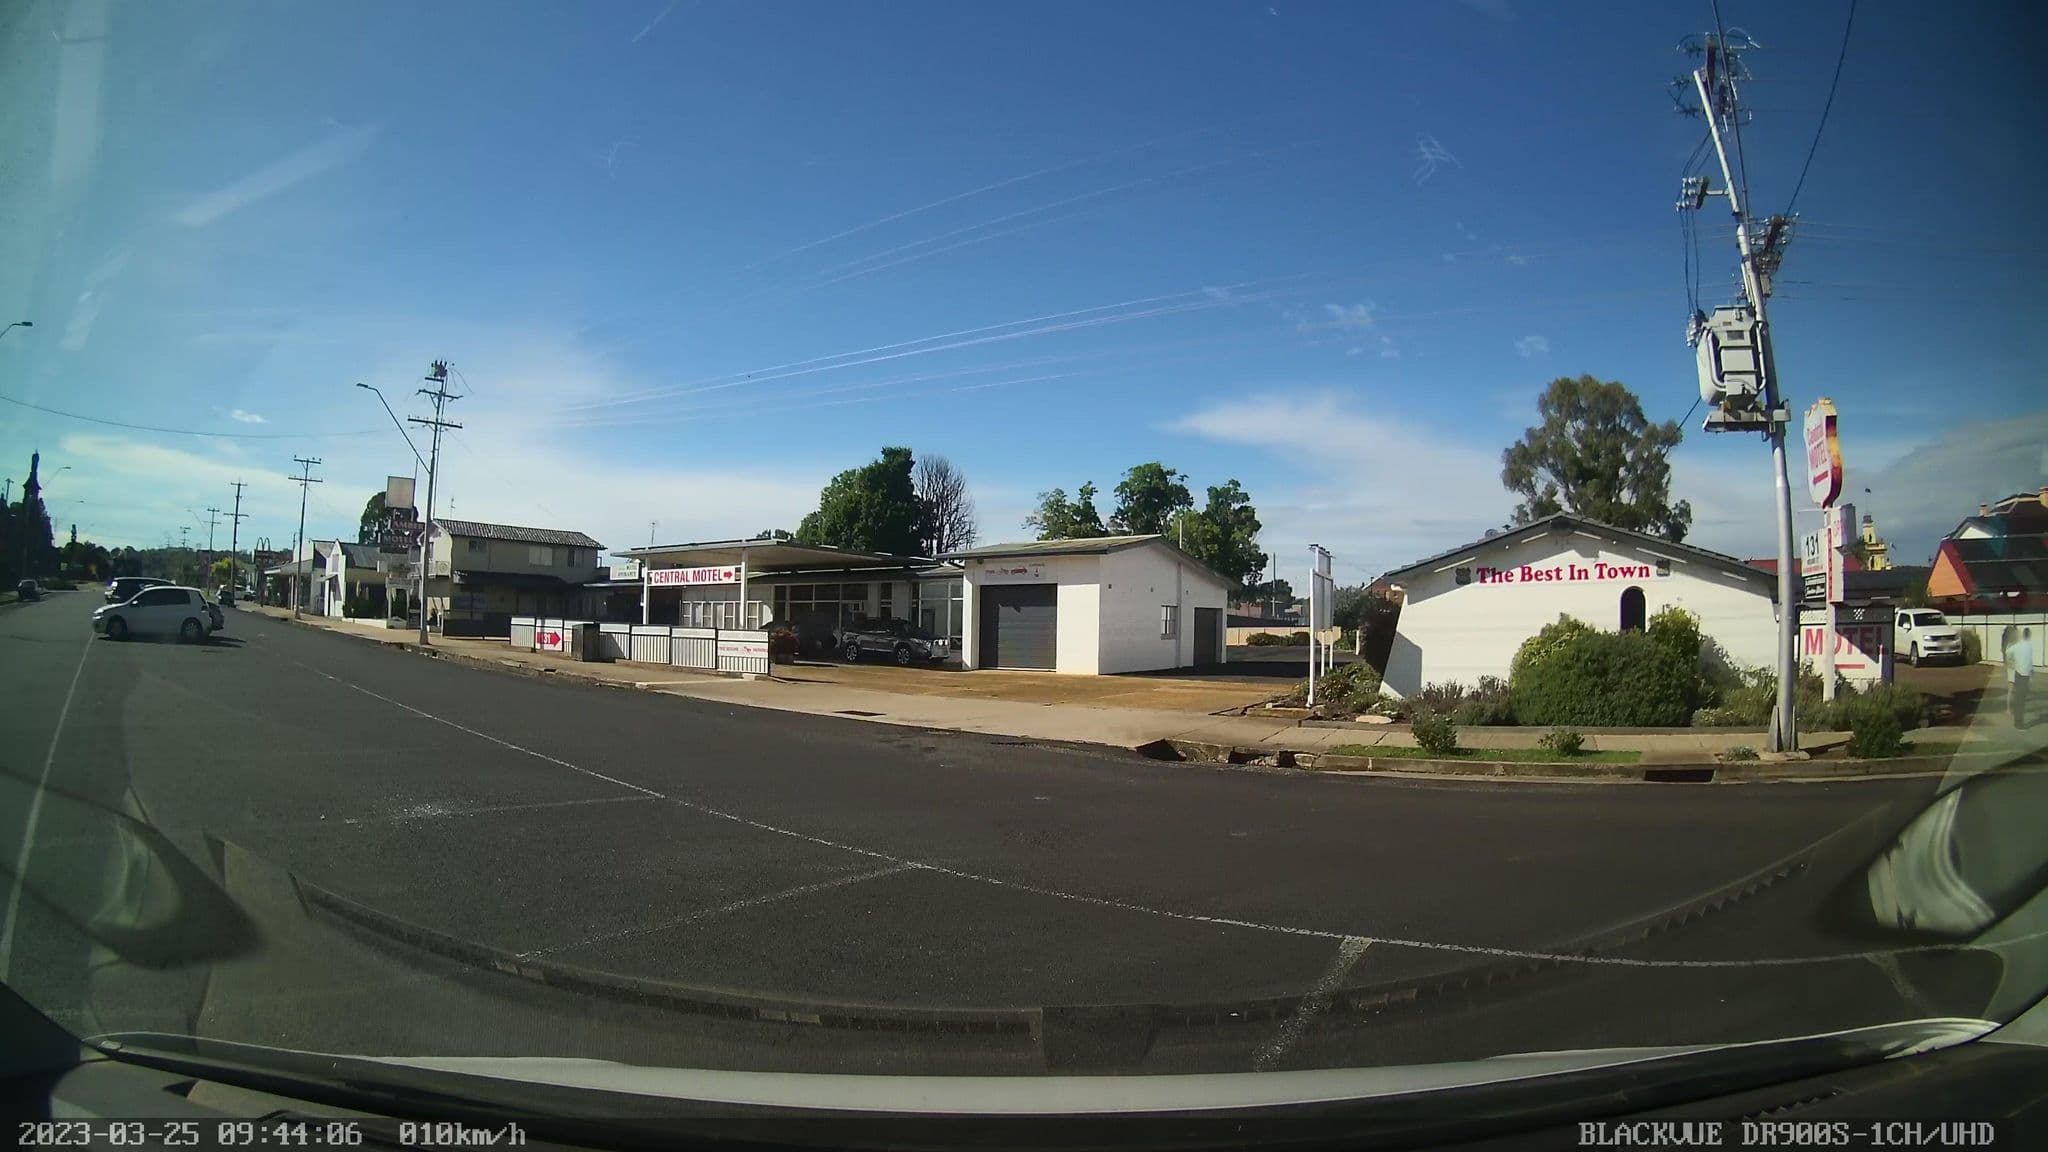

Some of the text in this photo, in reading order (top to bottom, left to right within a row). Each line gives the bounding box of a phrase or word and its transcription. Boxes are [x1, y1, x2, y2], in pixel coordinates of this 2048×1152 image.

[1806, 531, 1819, 557] 131
[654, 570, 690, 584] CENTRAL
[692, 568, 722, 583] MOTEL
[1476, 563, 1650, 584] The Best In Town
